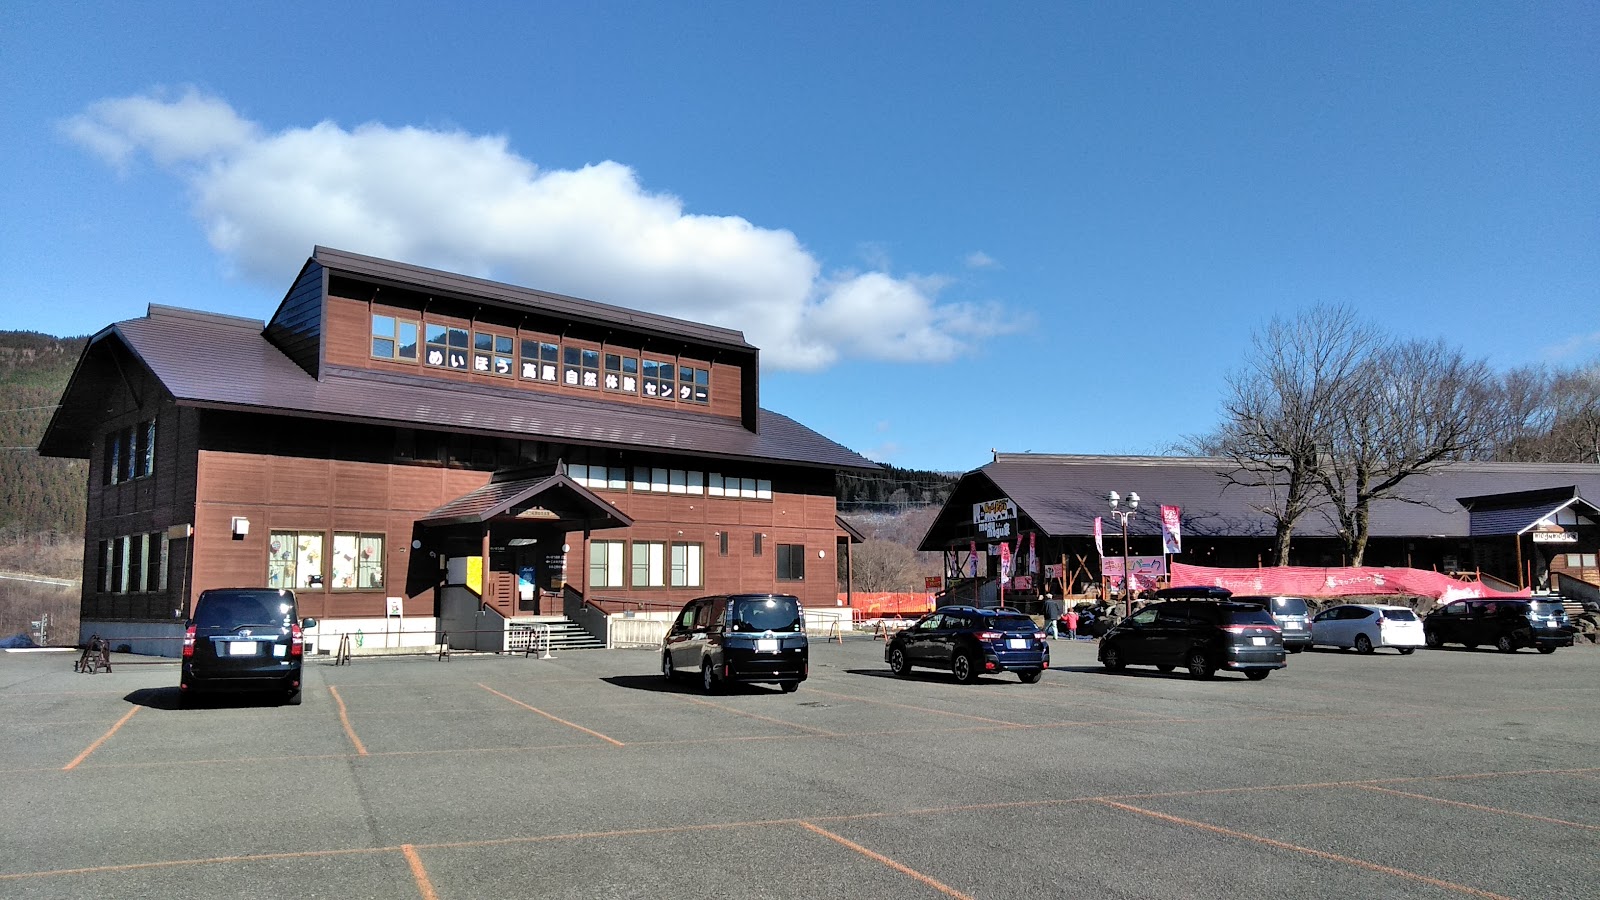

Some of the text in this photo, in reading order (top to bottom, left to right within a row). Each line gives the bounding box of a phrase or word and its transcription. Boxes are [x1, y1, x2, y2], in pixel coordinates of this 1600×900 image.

[428, 350, 707, 399] めいほう高原自然体験センター
